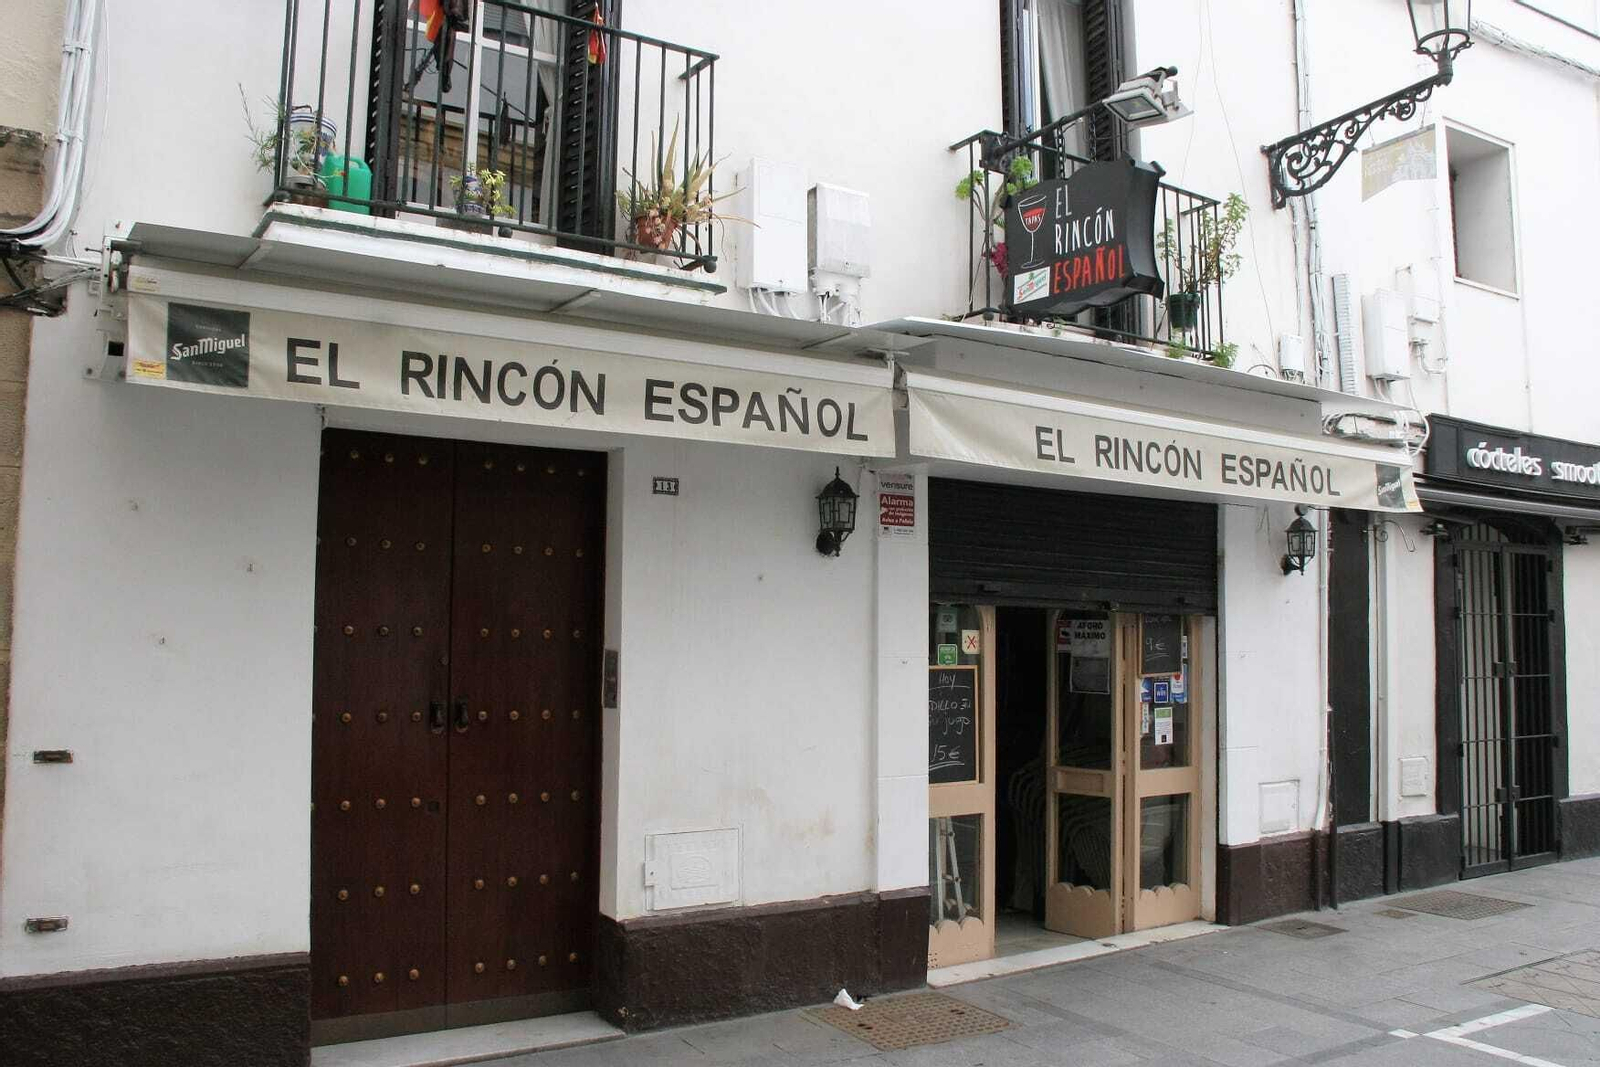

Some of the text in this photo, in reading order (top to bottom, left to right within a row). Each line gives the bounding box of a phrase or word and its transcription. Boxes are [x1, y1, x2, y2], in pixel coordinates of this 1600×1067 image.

[1054, 184, 1072, 219] EL
[1055, 207, 1115, 255] RINCÓN
[1053, 244, 1125, 294] ESPAÑOL
[286, 337, 869, 442] EL RINCÓN ESPAÑOL
[1035, 425, 1341, 497] EL RINCÓN ESPAÑOL
[881, 496, 914, 507] Alarma
[1077, 621, 1103, 630] AFORO
